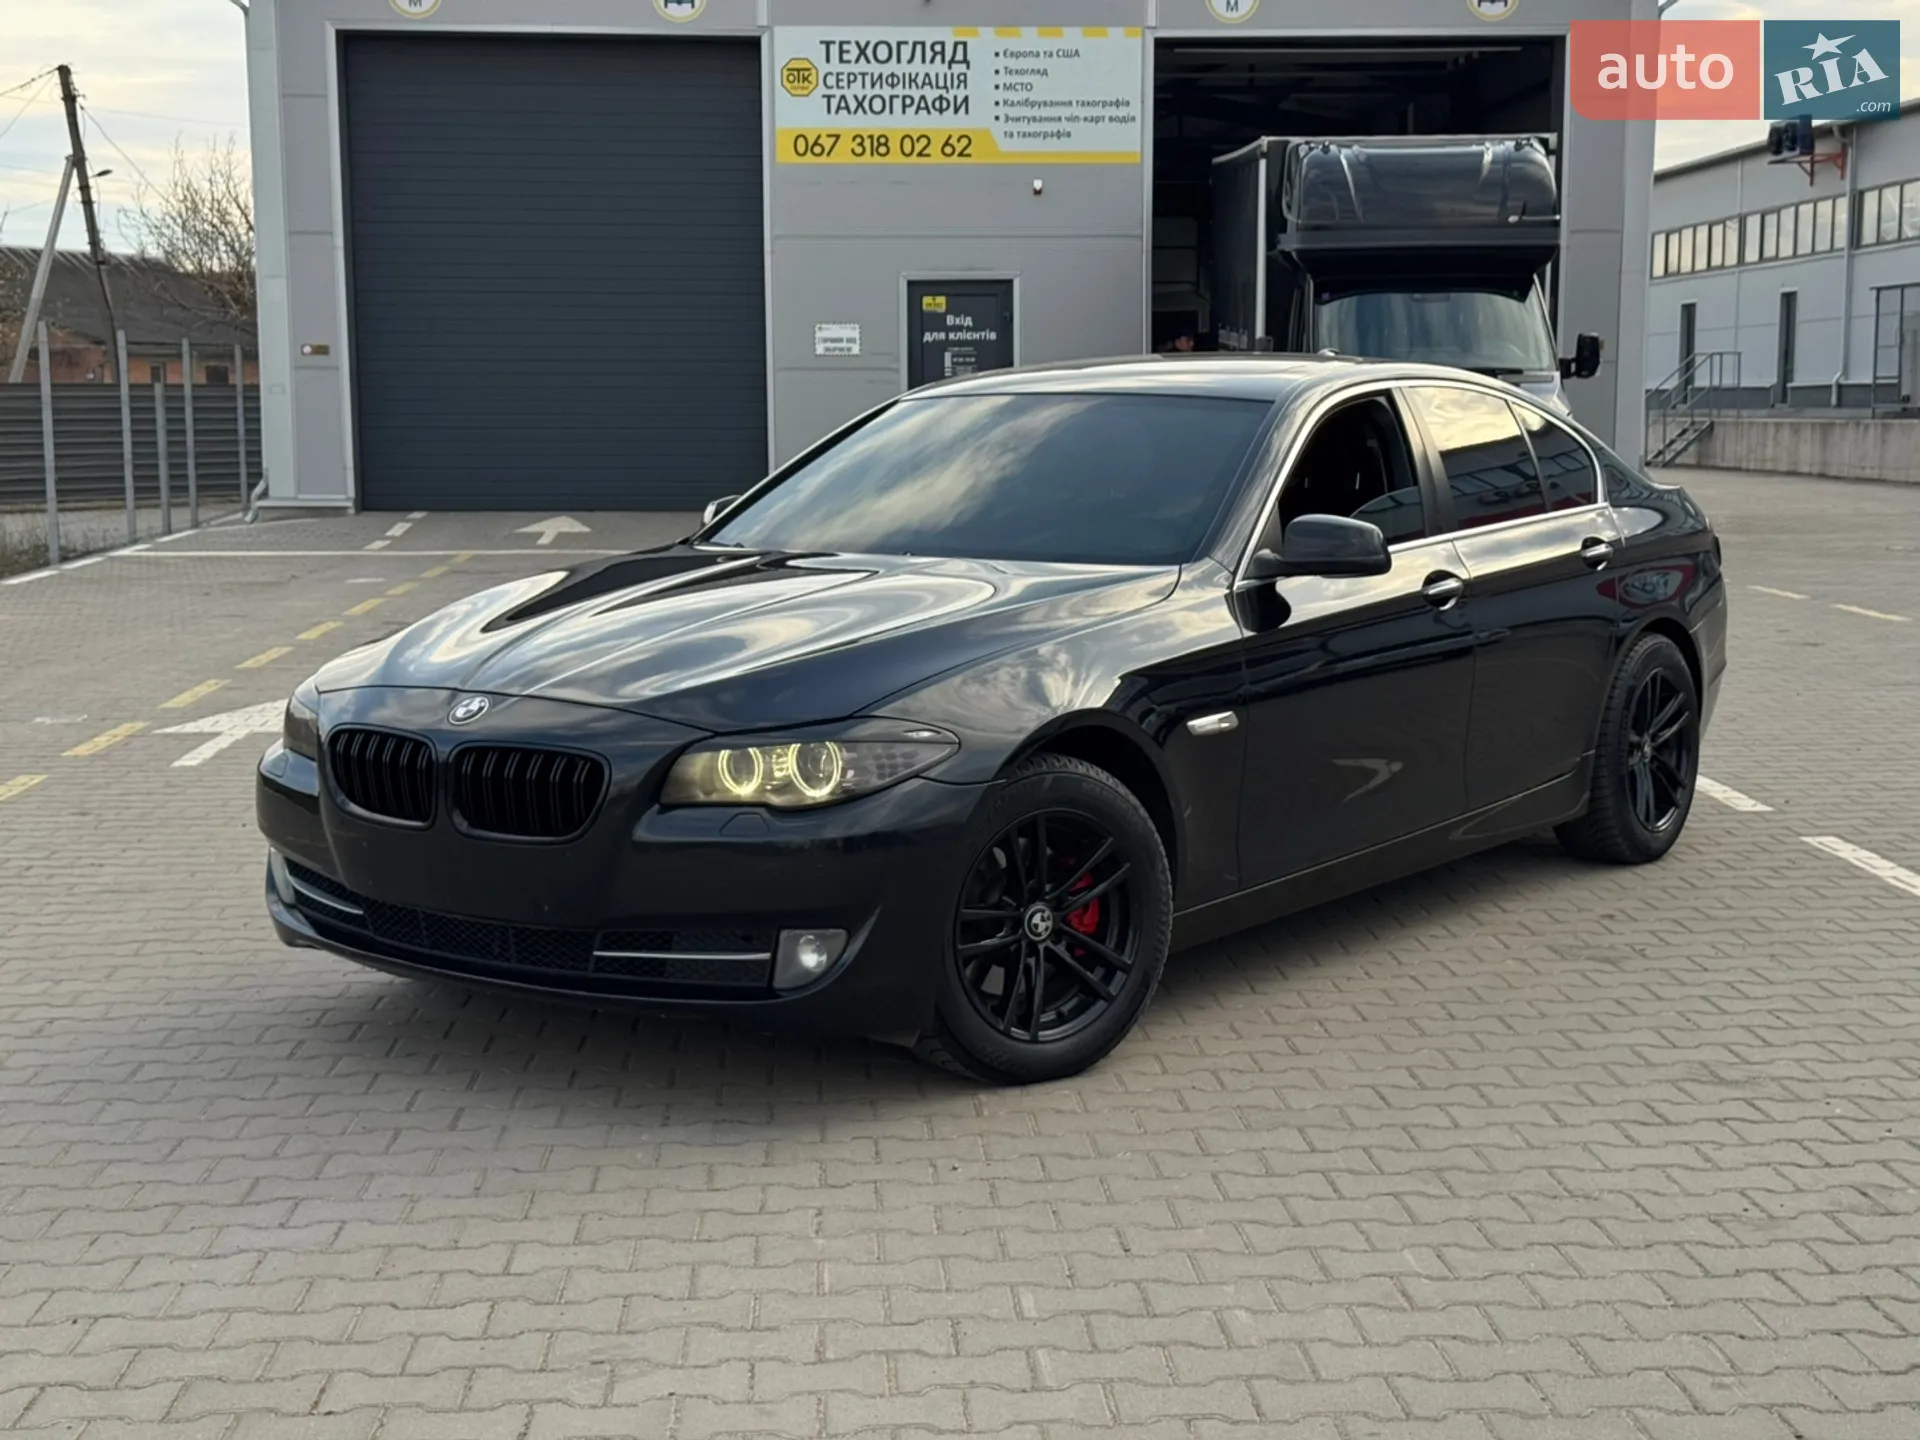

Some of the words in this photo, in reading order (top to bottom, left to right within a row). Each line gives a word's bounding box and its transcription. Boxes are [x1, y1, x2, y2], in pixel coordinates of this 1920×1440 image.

[819, 40, 971, 70] ТЕХОГЛЯД
[1043, 50, 1054, 59] та
[1055, 48, 1081, 59] США
[1003, 66, 1049, 77] Техогляд
[822, 71, 968, 94] СЕРТИФІКАЦІЯ
[1002, 82, 1034, 92] МСТО
[821, 93, 970, 116] ТАХОГРАФИ
[1002, 98, 1073, 109] Калібрування
[1075, 98, 1131, 109] тахографів
[1003, 113, 1063, 125] Зчитування
[1107, 112, 1136, 124] водія
[1003, 130, 1014, 139] та
[1016, 128, 1072, 140] тахографів
[793, 134, 841, 158] 067
[850, 134, 891, 158] 318
[899, 134, 931, 158] 02
[940, 134, 972, 158] 62
[946, 314, 973, 327] Вхід
[923, 331, 946, 343] для
[948, 329, 997, 341] клієнтів
